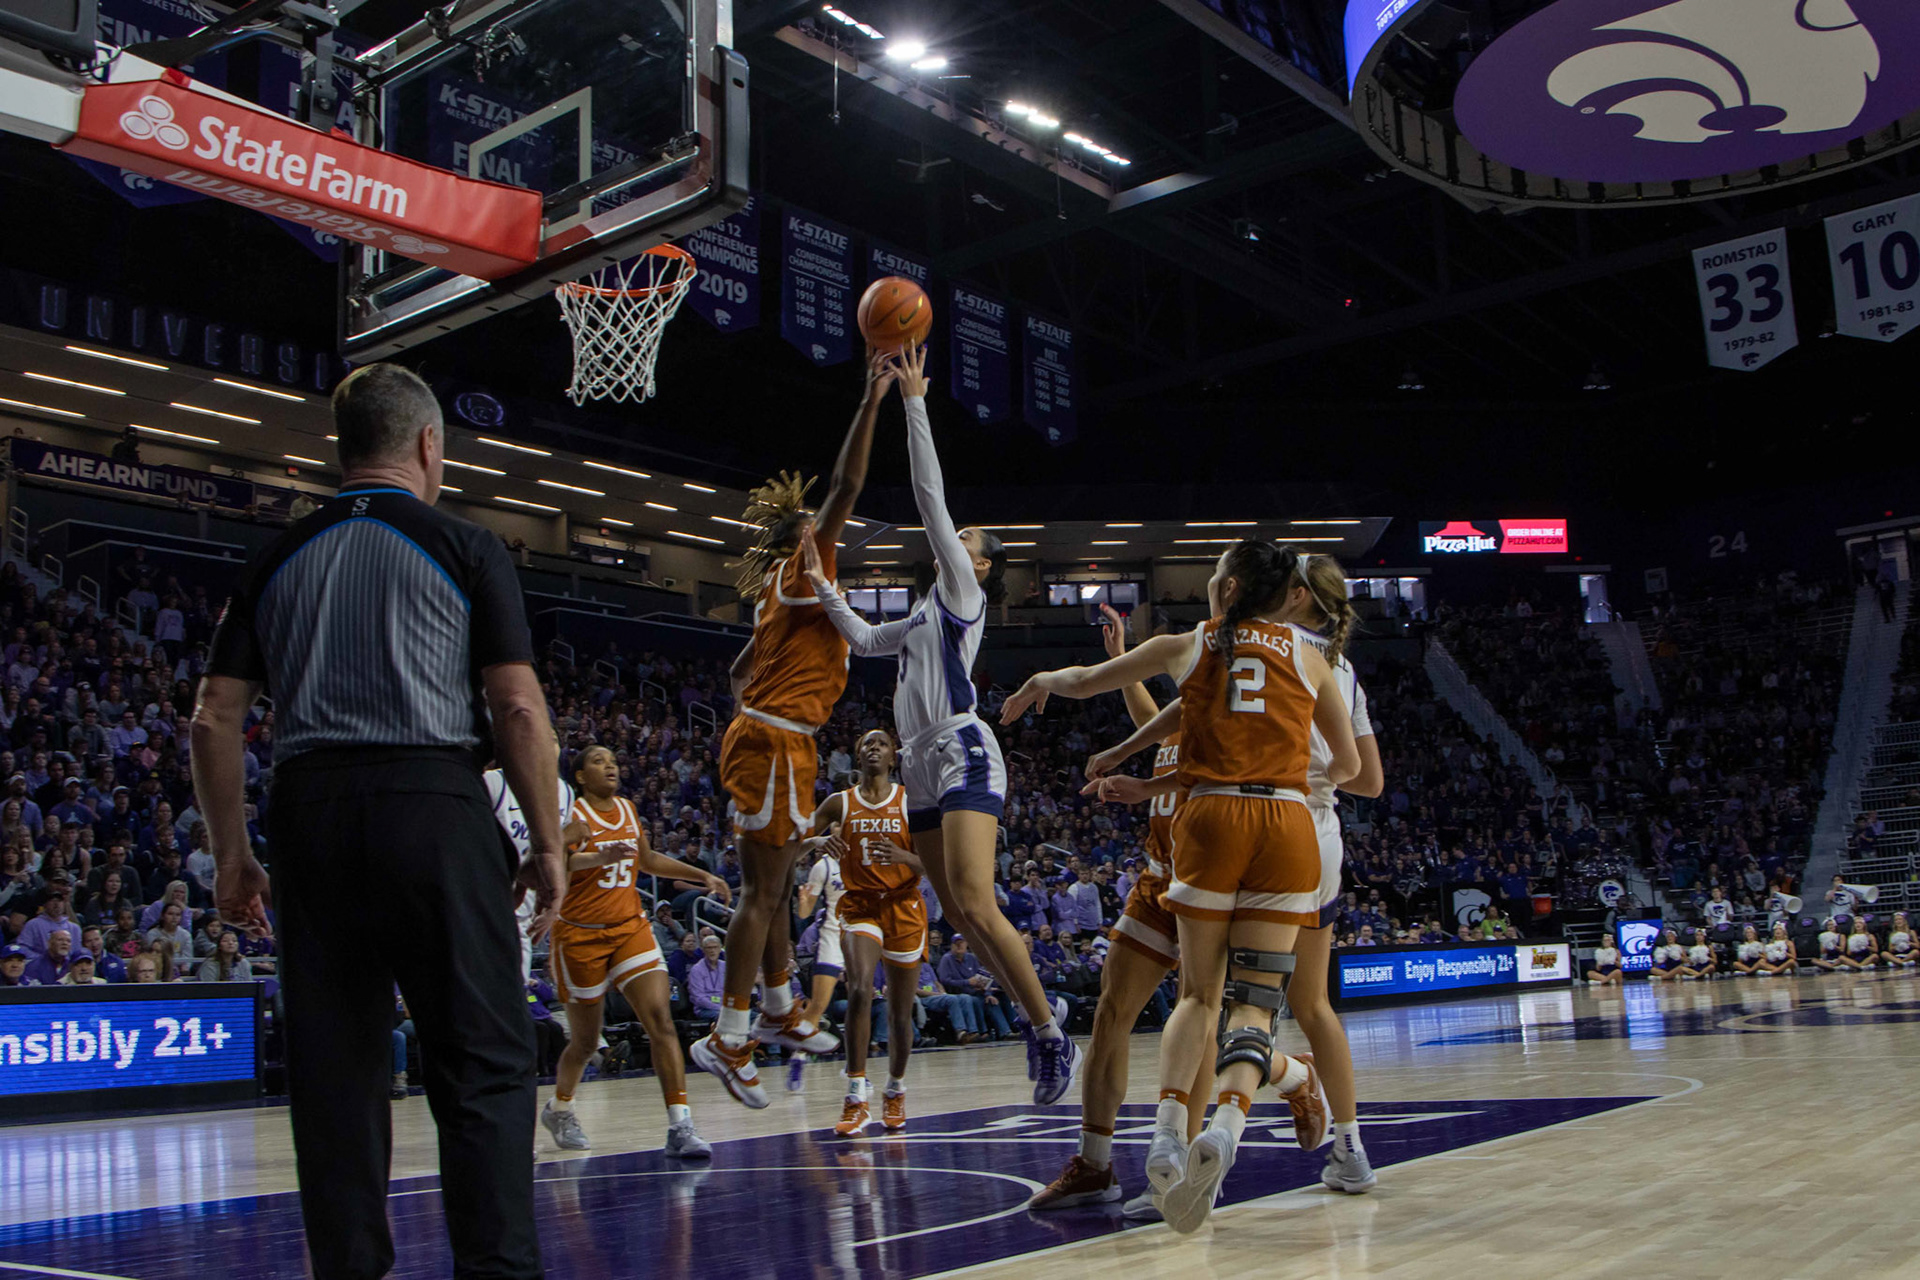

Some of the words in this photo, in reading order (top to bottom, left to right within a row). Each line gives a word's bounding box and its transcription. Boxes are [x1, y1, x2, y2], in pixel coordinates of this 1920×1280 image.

[97, 14, 170, 48] FIN
[439, 83, 542, 138] K-STA
[453, 140, 528, 184] FNAL
[727, 222, 742, 238] 12
[788, 216, 849, 251] K-STATE
[1852, 212, 1897, 234] GARY
[688, 237, 759, 275] CHAMPIONS
[691, 228, 759, 258] ONFERENCE
[1702, 242, 1778, 270] ROMSTAD
[872, 248, 928, 280] K-STATE
[1839, 231, 1920, 300] 10
[698, 268, 749, 304] 2019
[1706, 263, 1784, 332] 33
[954, 288, 1005, 319] K-STATE
[1859, 300, 1915, 322] 1981-83
[41, 284, 330, 391] UNIVERSI
[1724, 332, 1775, 351] 1979-82
[1708, 530, 1749, 559] 24
[1204, 628, 1294, 658] GZALES
[1230, 657, 1267, 714] 2
[1154, 744, 1179, 768] EXA
[850, 818, 902, 833] TEXAS
[597, 858, 635, 889] 35
[1343, 967, 1365, 984] BUD
[1365, 966, 1394, 982] LIGHT
[1404, 959, 1436, 984] Enjoy
[1436, 955, 1497, 980] Responsibly
[1497, 954, 1515, 972] 21+
[1620, 954, 1652, 965] K-STA
[0, 1018, 142, 1070] nsibly
[153, 1016, 232, 1058] 21+
